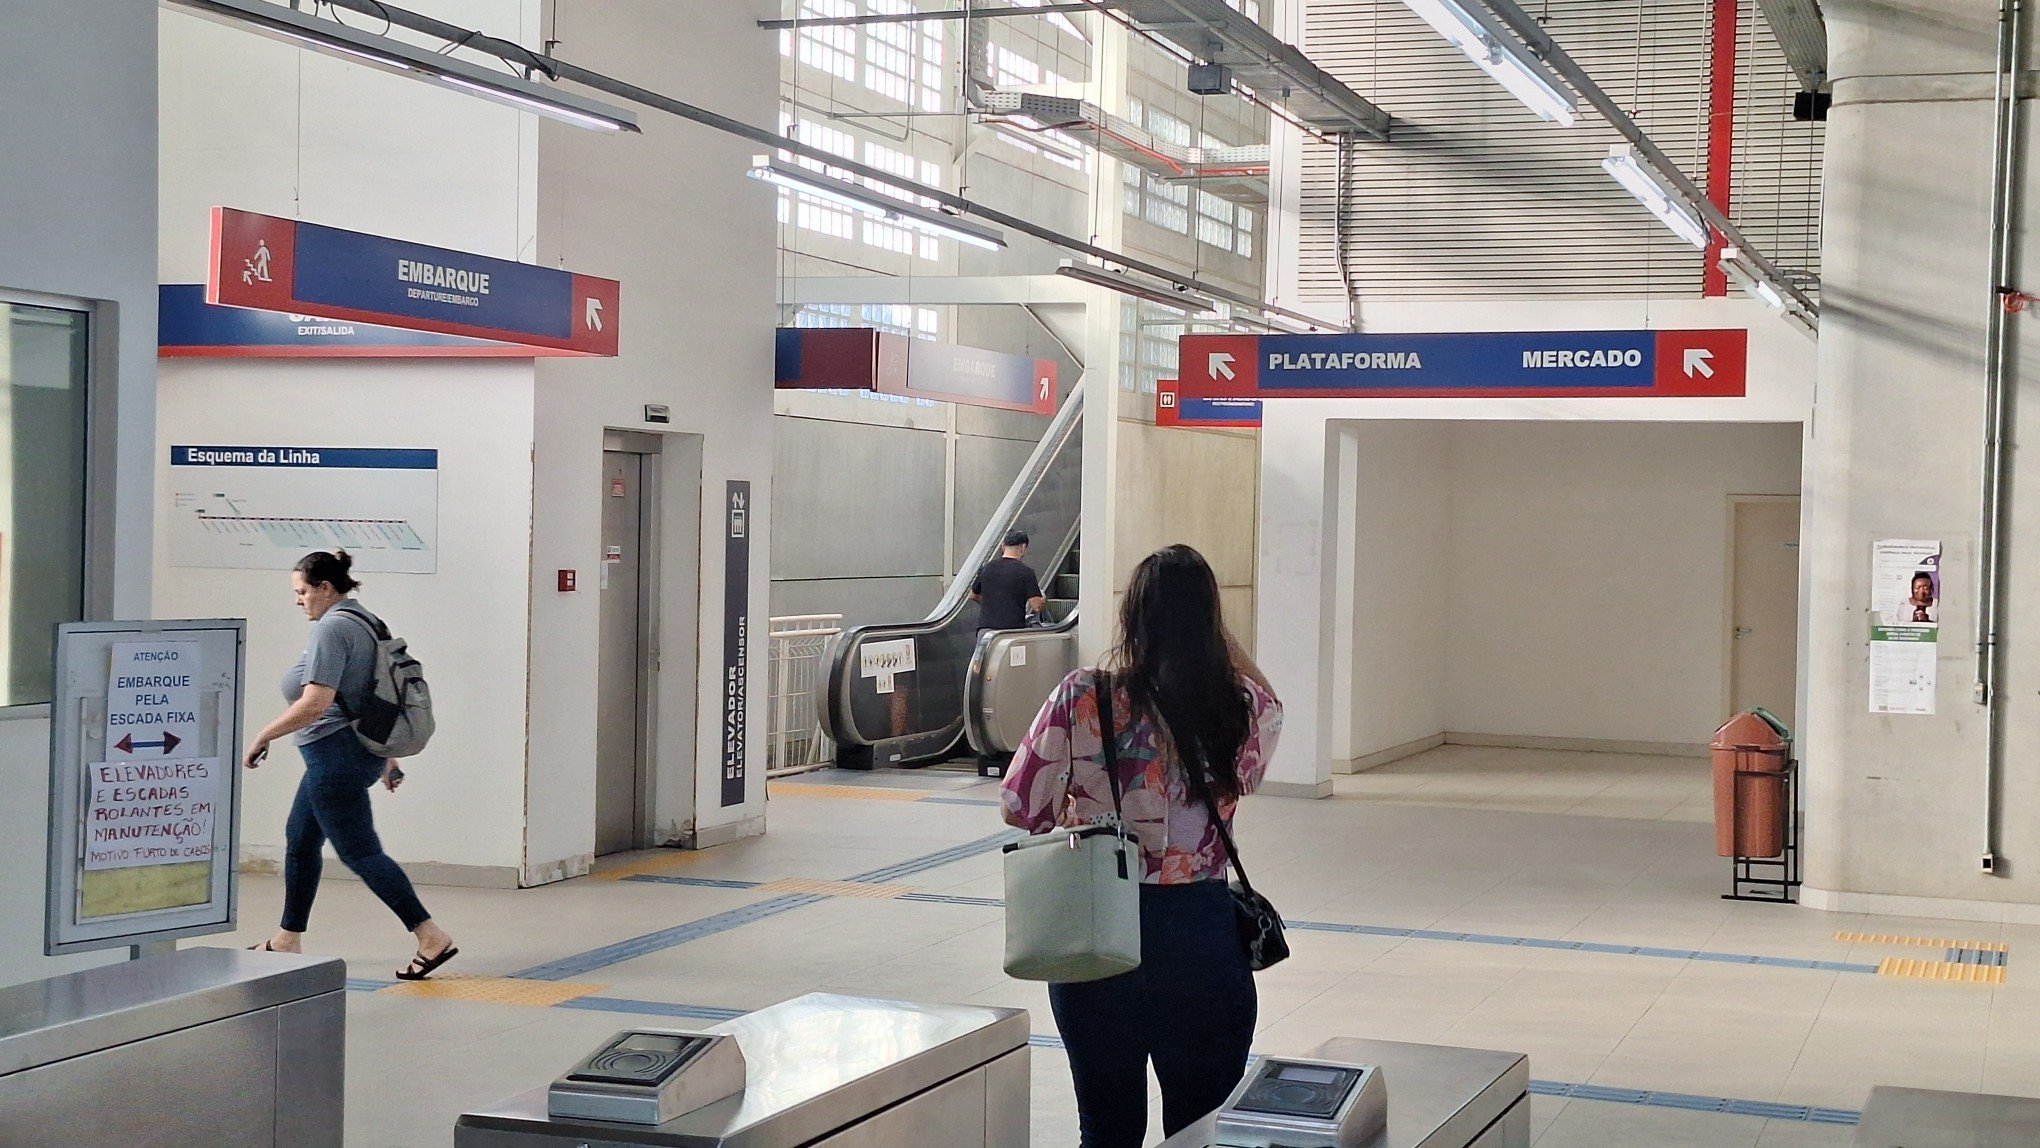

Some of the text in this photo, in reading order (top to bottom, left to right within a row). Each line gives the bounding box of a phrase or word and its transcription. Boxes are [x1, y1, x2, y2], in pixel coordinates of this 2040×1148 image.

[398, 259, 490, 295] EMBARQUE
[297, 326, 355, 336] EXIT/SALIDA
[1268, 352, 1422, 370] PLATAFORMA
[1521, 349, 1642, 369] MERCADO
[187, 447, 320, 466] Esquema da Linha
[133, 651, 179, 663] ATENÇÃO
[117, 675, 190, 689] EMBARQUE
[135, 694, 169, 706] PELA
[736, 616, 746, 778] ELEVATOR/ASCENSOR
[110, 711, 196, 726] ESCADA FIXA
[727, 665, 736, 780] ELEVADOR
[99, 763, 209, 783] ELEVADORES
[96, 786, 189, 803] E ESCADAS
[94, 802, 211, 821] ROLANTES EM
[94, 817, 207, 844] MANUTENÇÃO!
[91, 845, 211, 862] MOTIVO FURTO DE CABOS
